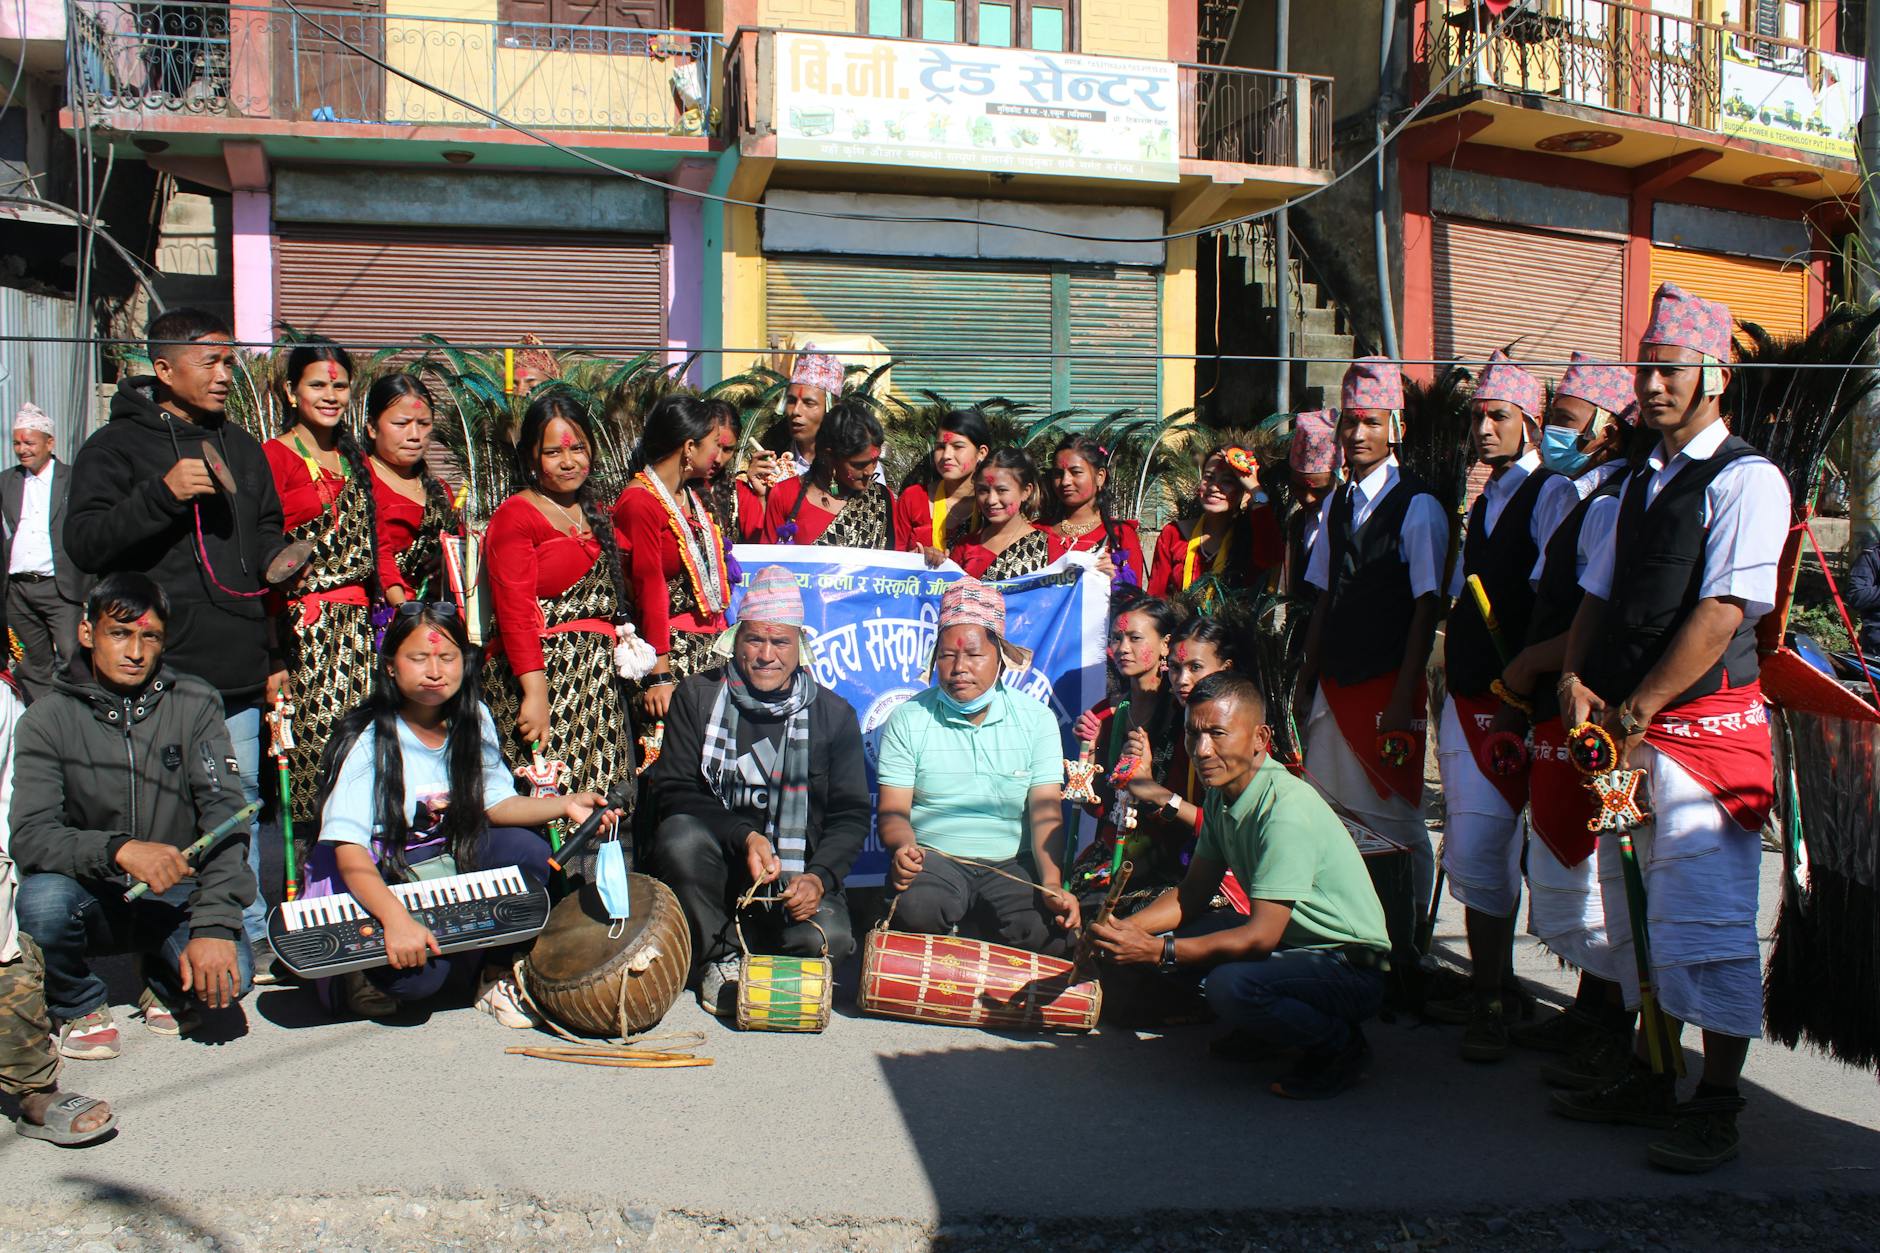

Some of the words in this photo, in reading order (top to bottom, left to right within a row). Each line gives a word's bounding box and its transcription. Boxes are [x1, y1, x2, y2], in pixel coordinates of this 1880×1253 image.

[919, 47, 1000, 104] ट्रेड
[1019, 56, 1170, 112] सेन्टर
[1724, 122, 1747, 133] BUDDHA
[1748, 127, 1769, 138] POWER
[1775, 132, 1812, 147] TECHNOLOGY
[818, 573, 854, 591] कला
[858, 576, 869, 592] र
